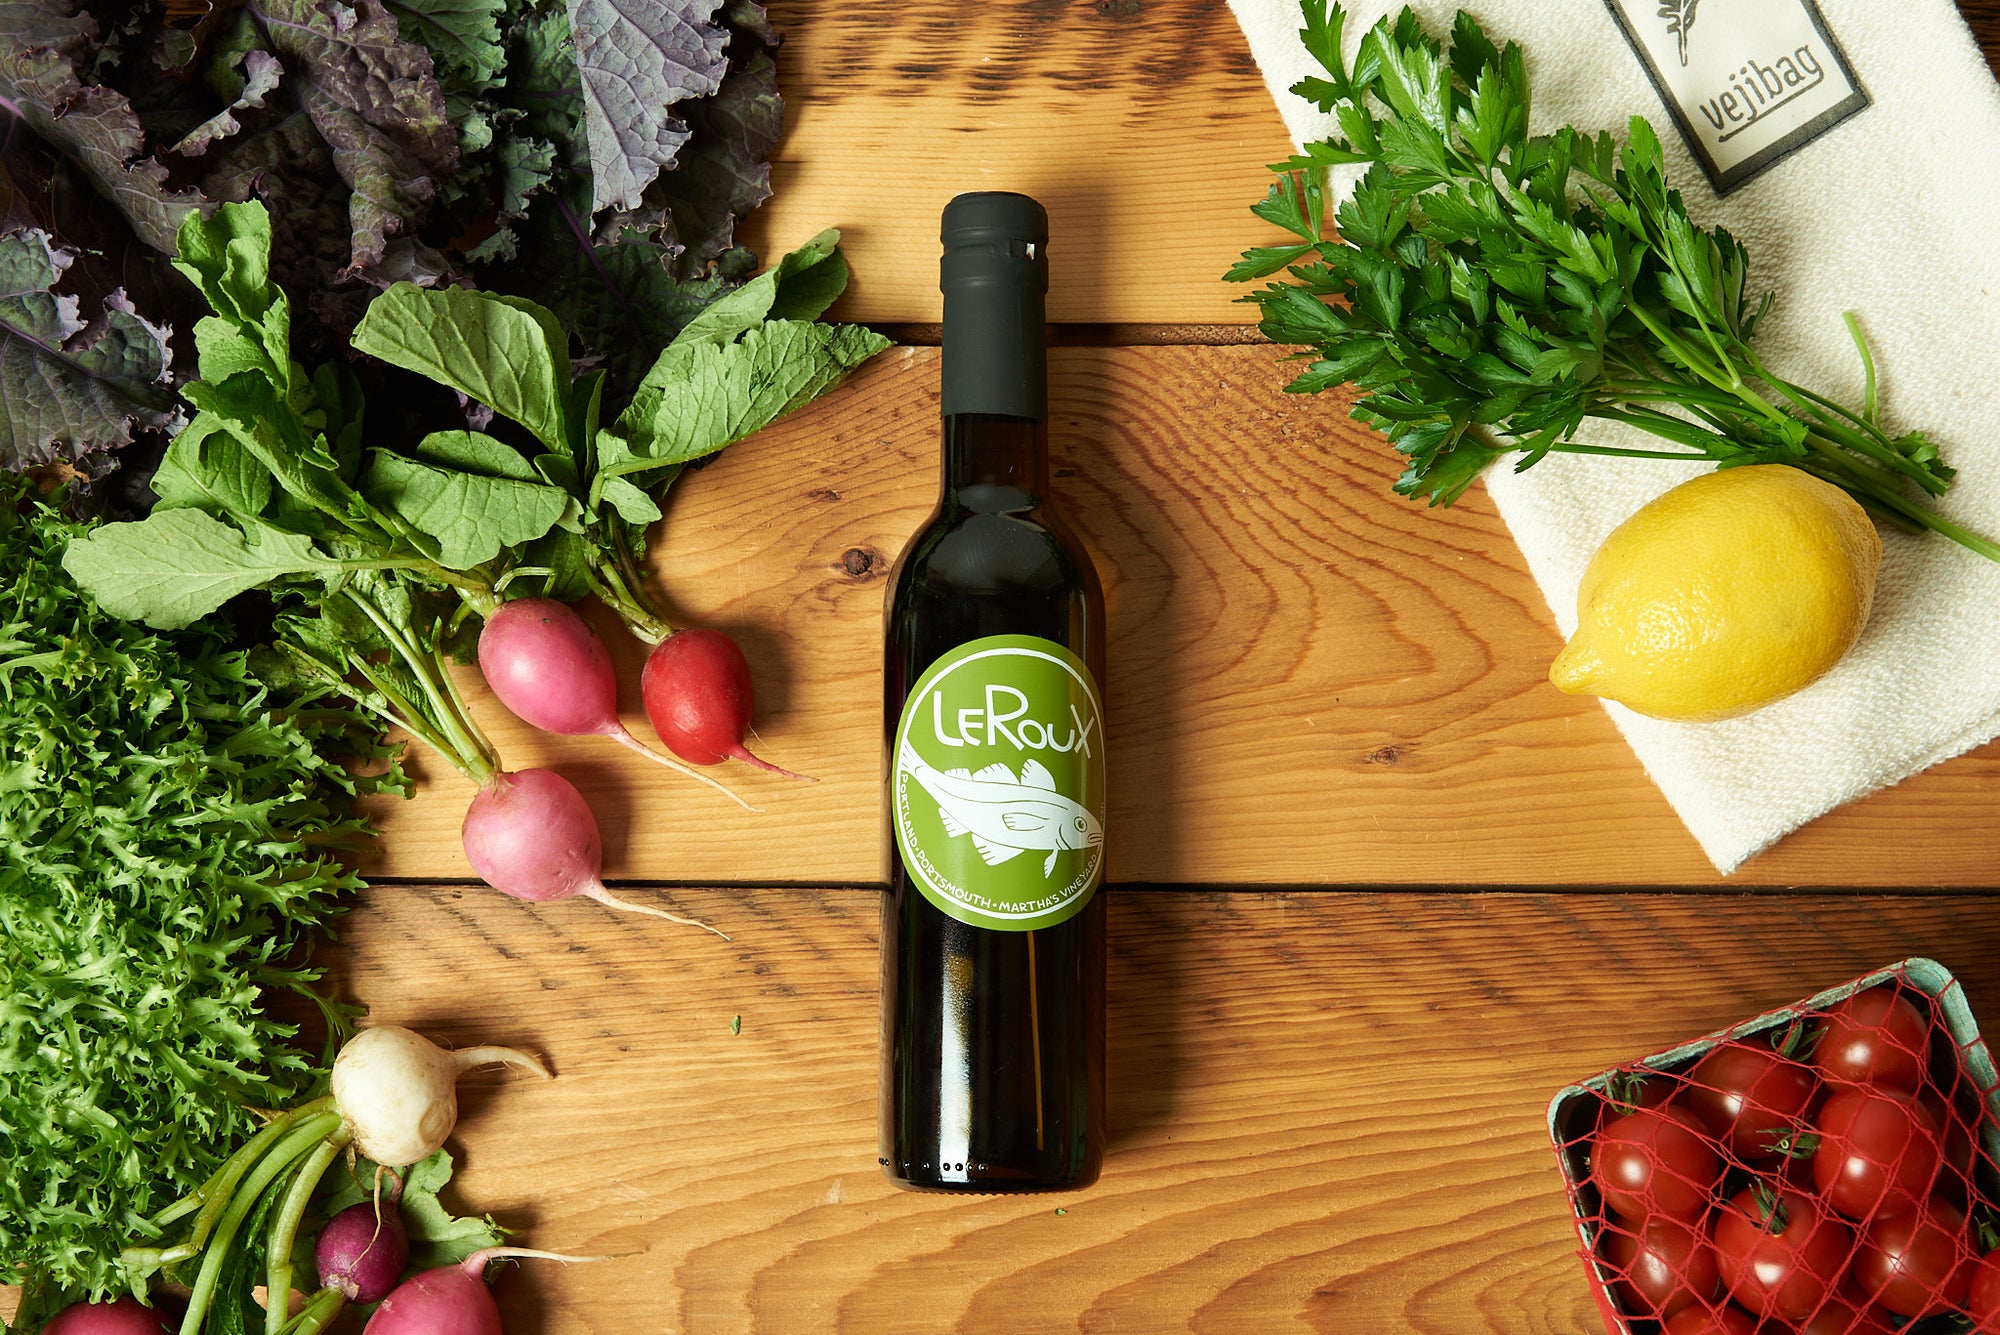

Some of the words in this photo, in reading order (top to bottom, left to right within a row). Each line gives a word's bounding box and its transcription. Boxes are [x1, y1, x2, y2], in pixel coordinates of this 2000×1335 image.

[1699, 45, 1824, 141] vejibag
[900, 773, 918, 848] PORTLAND
[916, 849, 991, 909] PORTSMOUTH
[998, 893, 1060, 913] MARTHA'S
